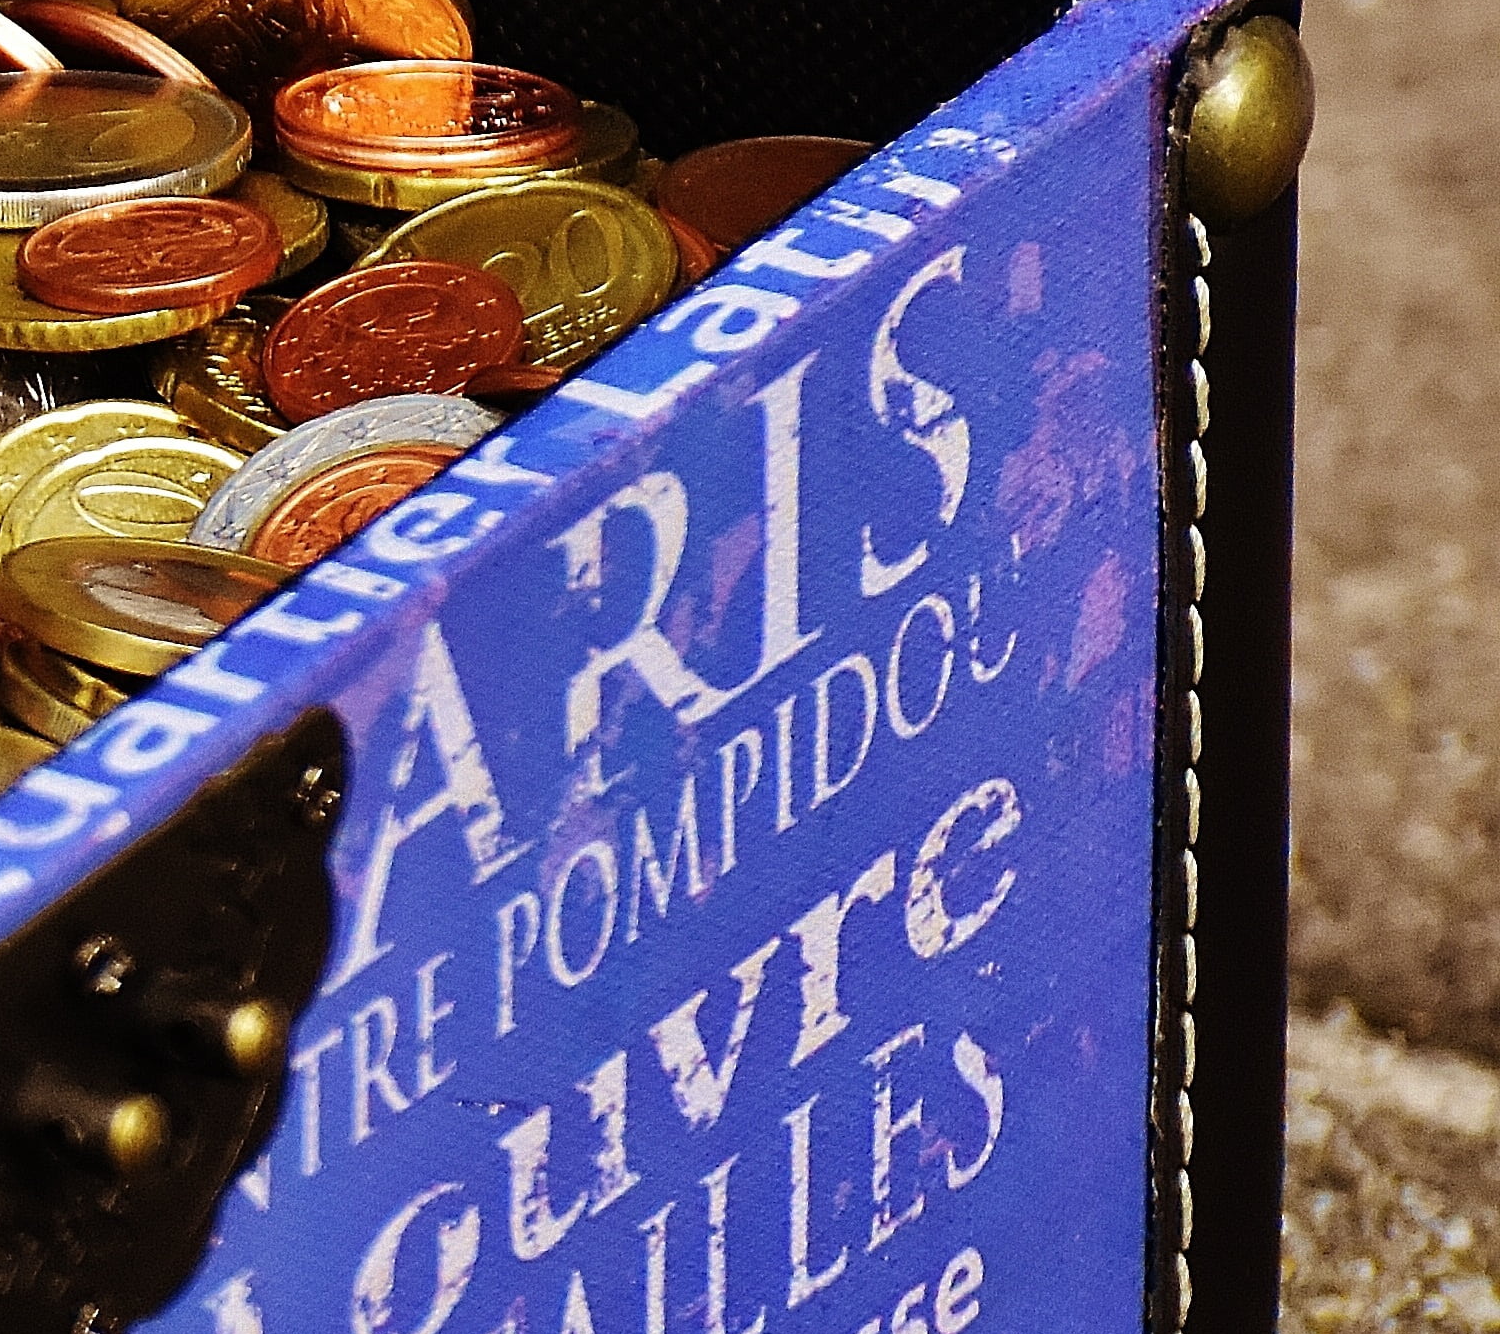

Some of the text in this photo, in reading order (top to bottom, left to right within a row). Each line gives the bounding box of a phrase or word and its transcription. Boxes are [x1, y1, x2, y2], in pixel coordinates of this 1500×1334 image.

[562, 125, 1020, 423] Latin
[315, 243, 973, 999] ARIS
[494, 535, 1022, 1034] POMPIDOU
